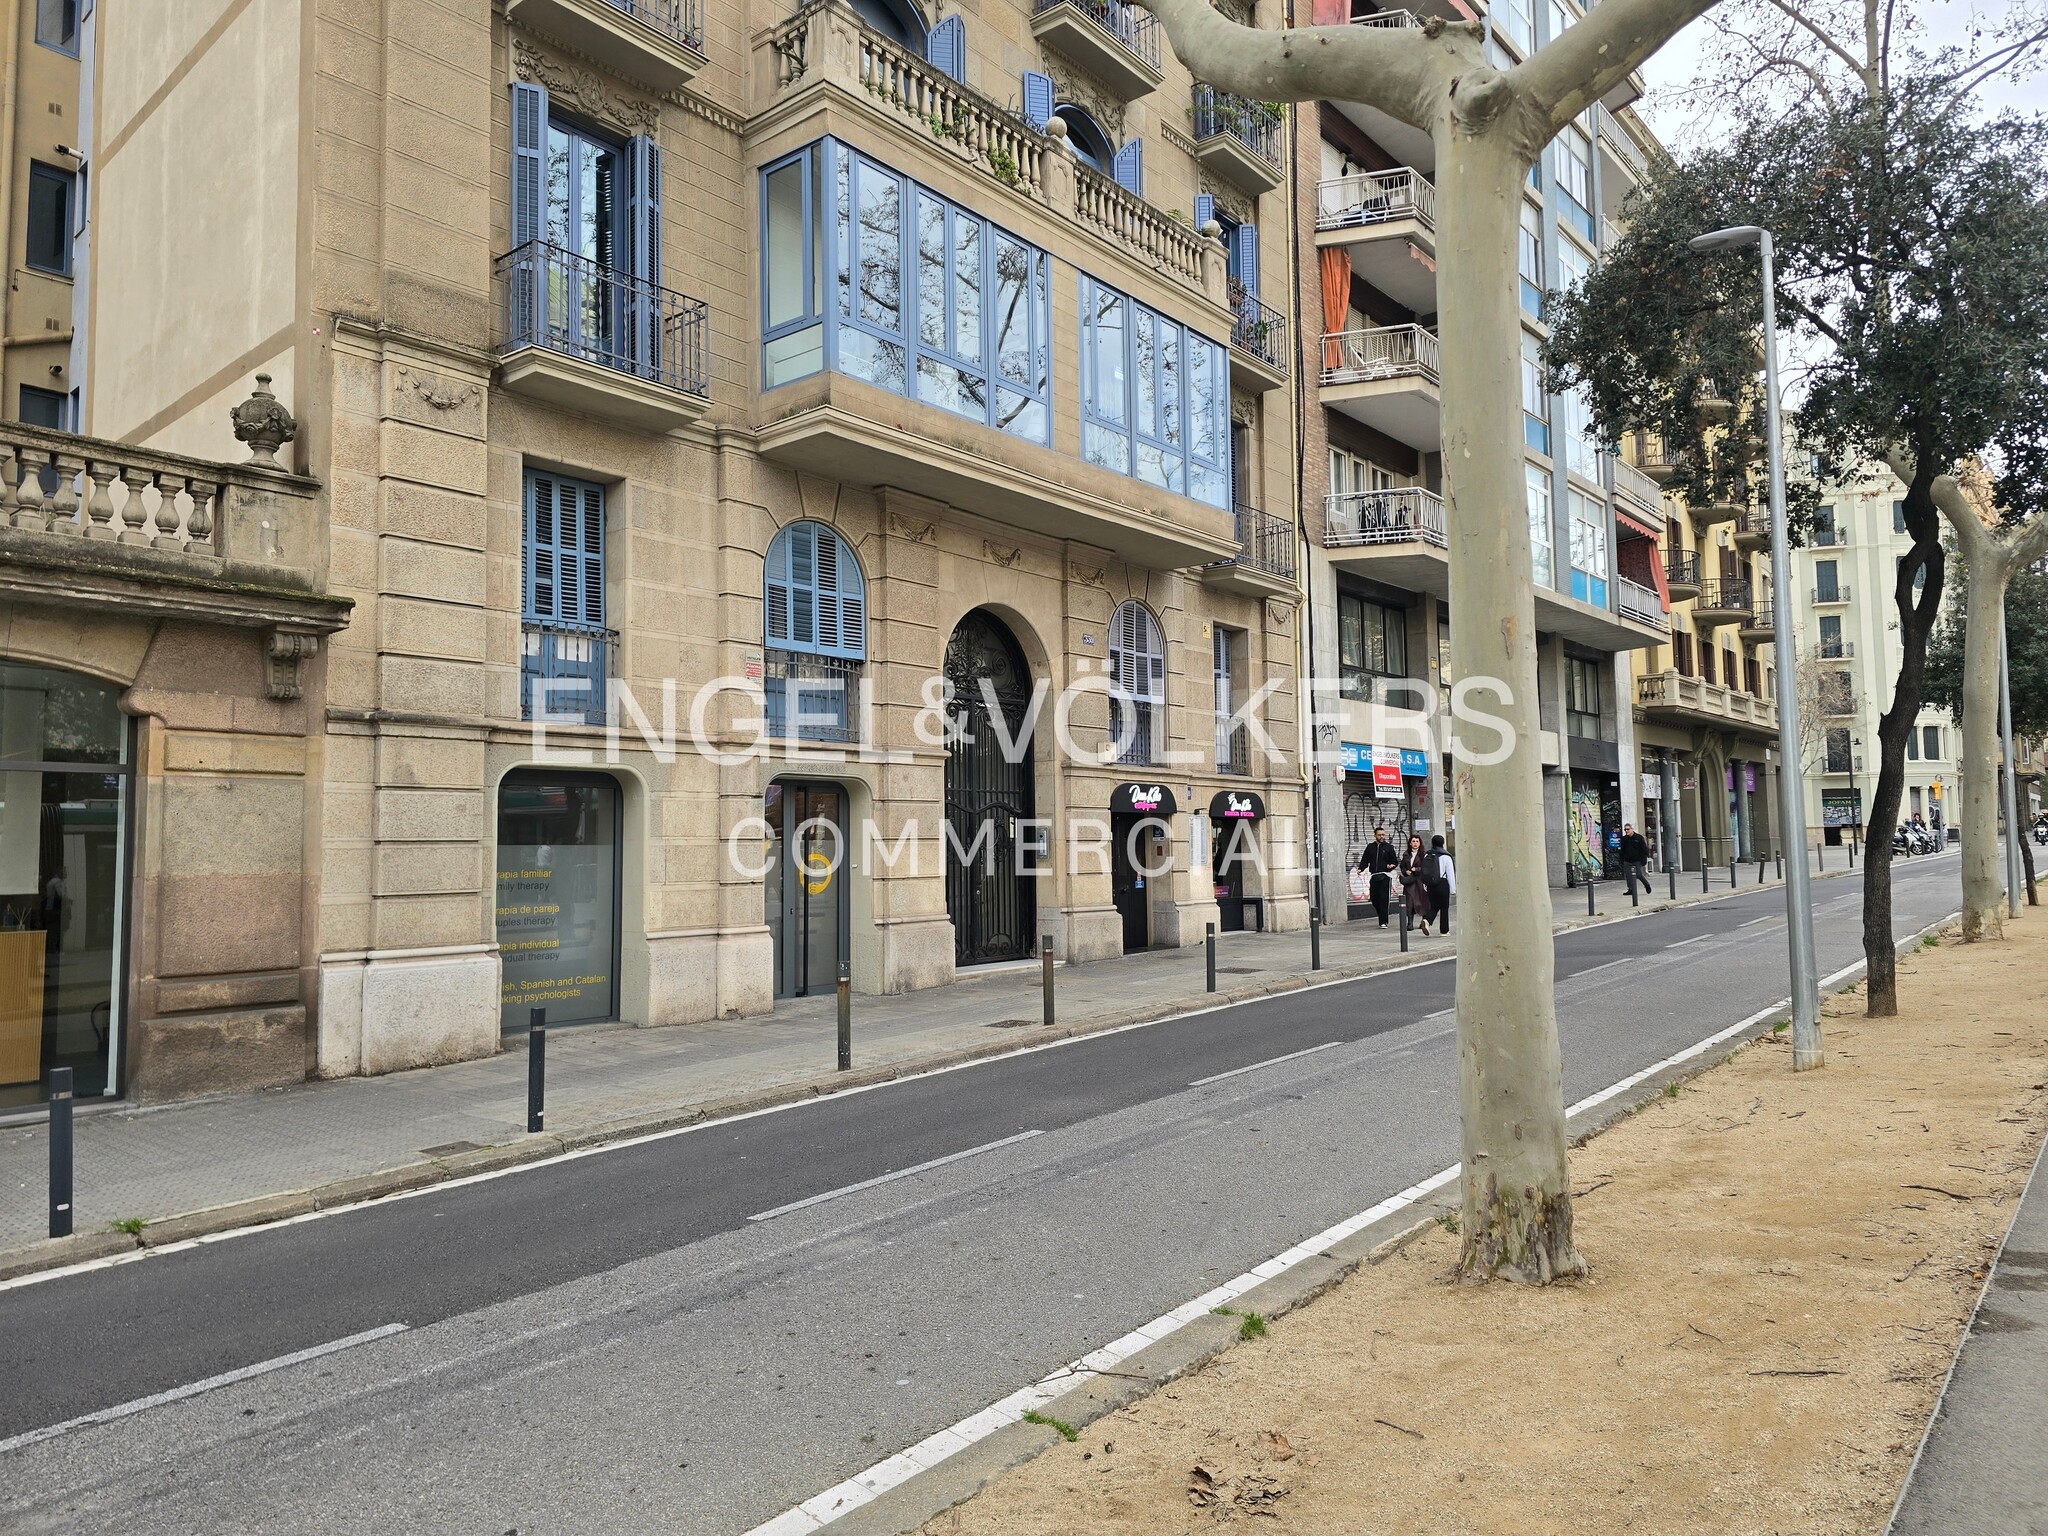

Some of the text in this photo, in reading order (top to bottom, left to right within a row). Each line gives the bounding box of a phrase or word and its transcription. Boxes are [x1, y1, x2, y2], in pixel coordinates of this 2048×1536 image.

[496, 869, 552, 880] rapia familiar
[496, 882, 550, 892] mily therapy
[496, 904, 560, 916] rapia de pareja
[495, 916, 556, 927] uples therapy
[498, 939, 560, 951] apia individual
[528, 952, 560, 963] therapy
[502, 975, 606, 992] ish, Spanish and Catalan
[500, 989, 581, 1004] king psychologists
